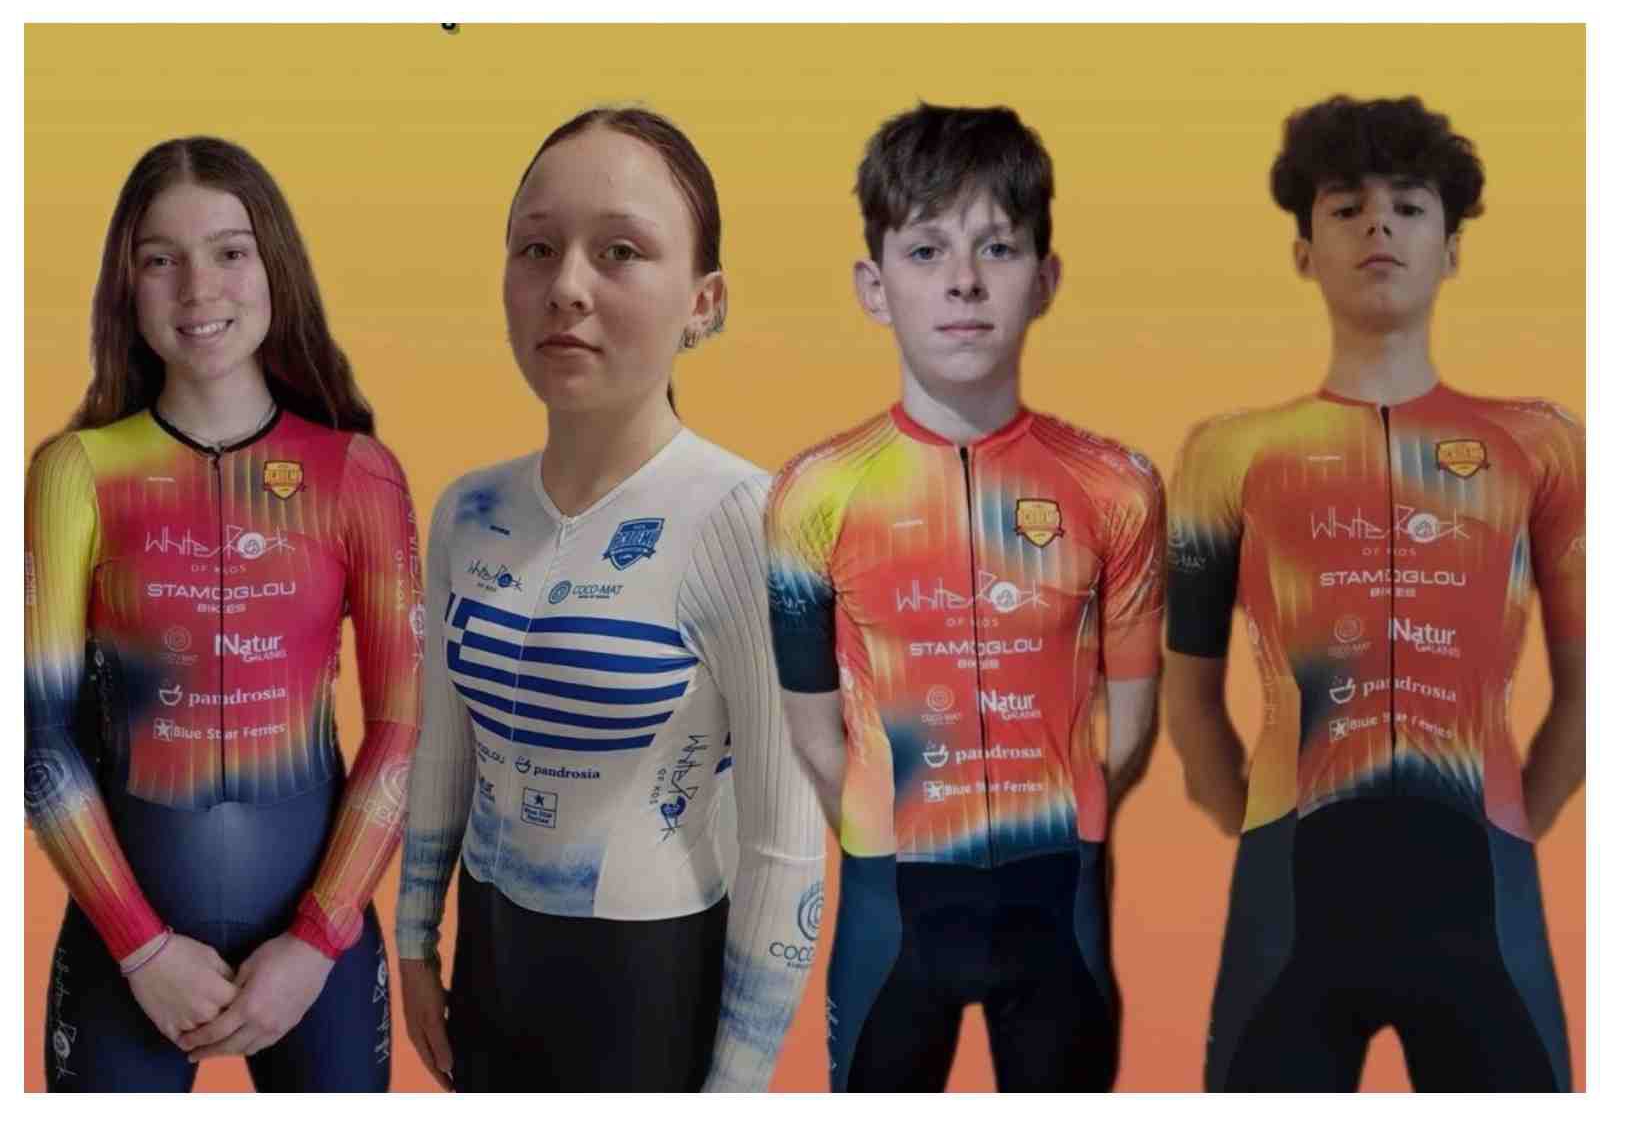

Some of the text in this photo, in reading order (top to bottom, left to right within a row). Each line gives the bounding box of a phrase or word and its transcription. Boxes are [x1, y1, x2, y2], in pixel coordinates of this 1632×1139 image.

[1320, 569, 1466, 586] STAMOGLOU
[147, 581, 296, 600] STAMOGLOU
[1387, 617, 1456, 644] Natur
[215, 633, 283, 656] Natur
[910, 637, 1043, 656] STAMOGLOU
[189, 687, 286, 707] pandrosia
[1362, 676, 1456, 701] pandrosia
[976, 690, 1035, 713] Natur
[955, 744, 1042, 764] pandrosia
[533, 765, 600, 779] pandrosia
